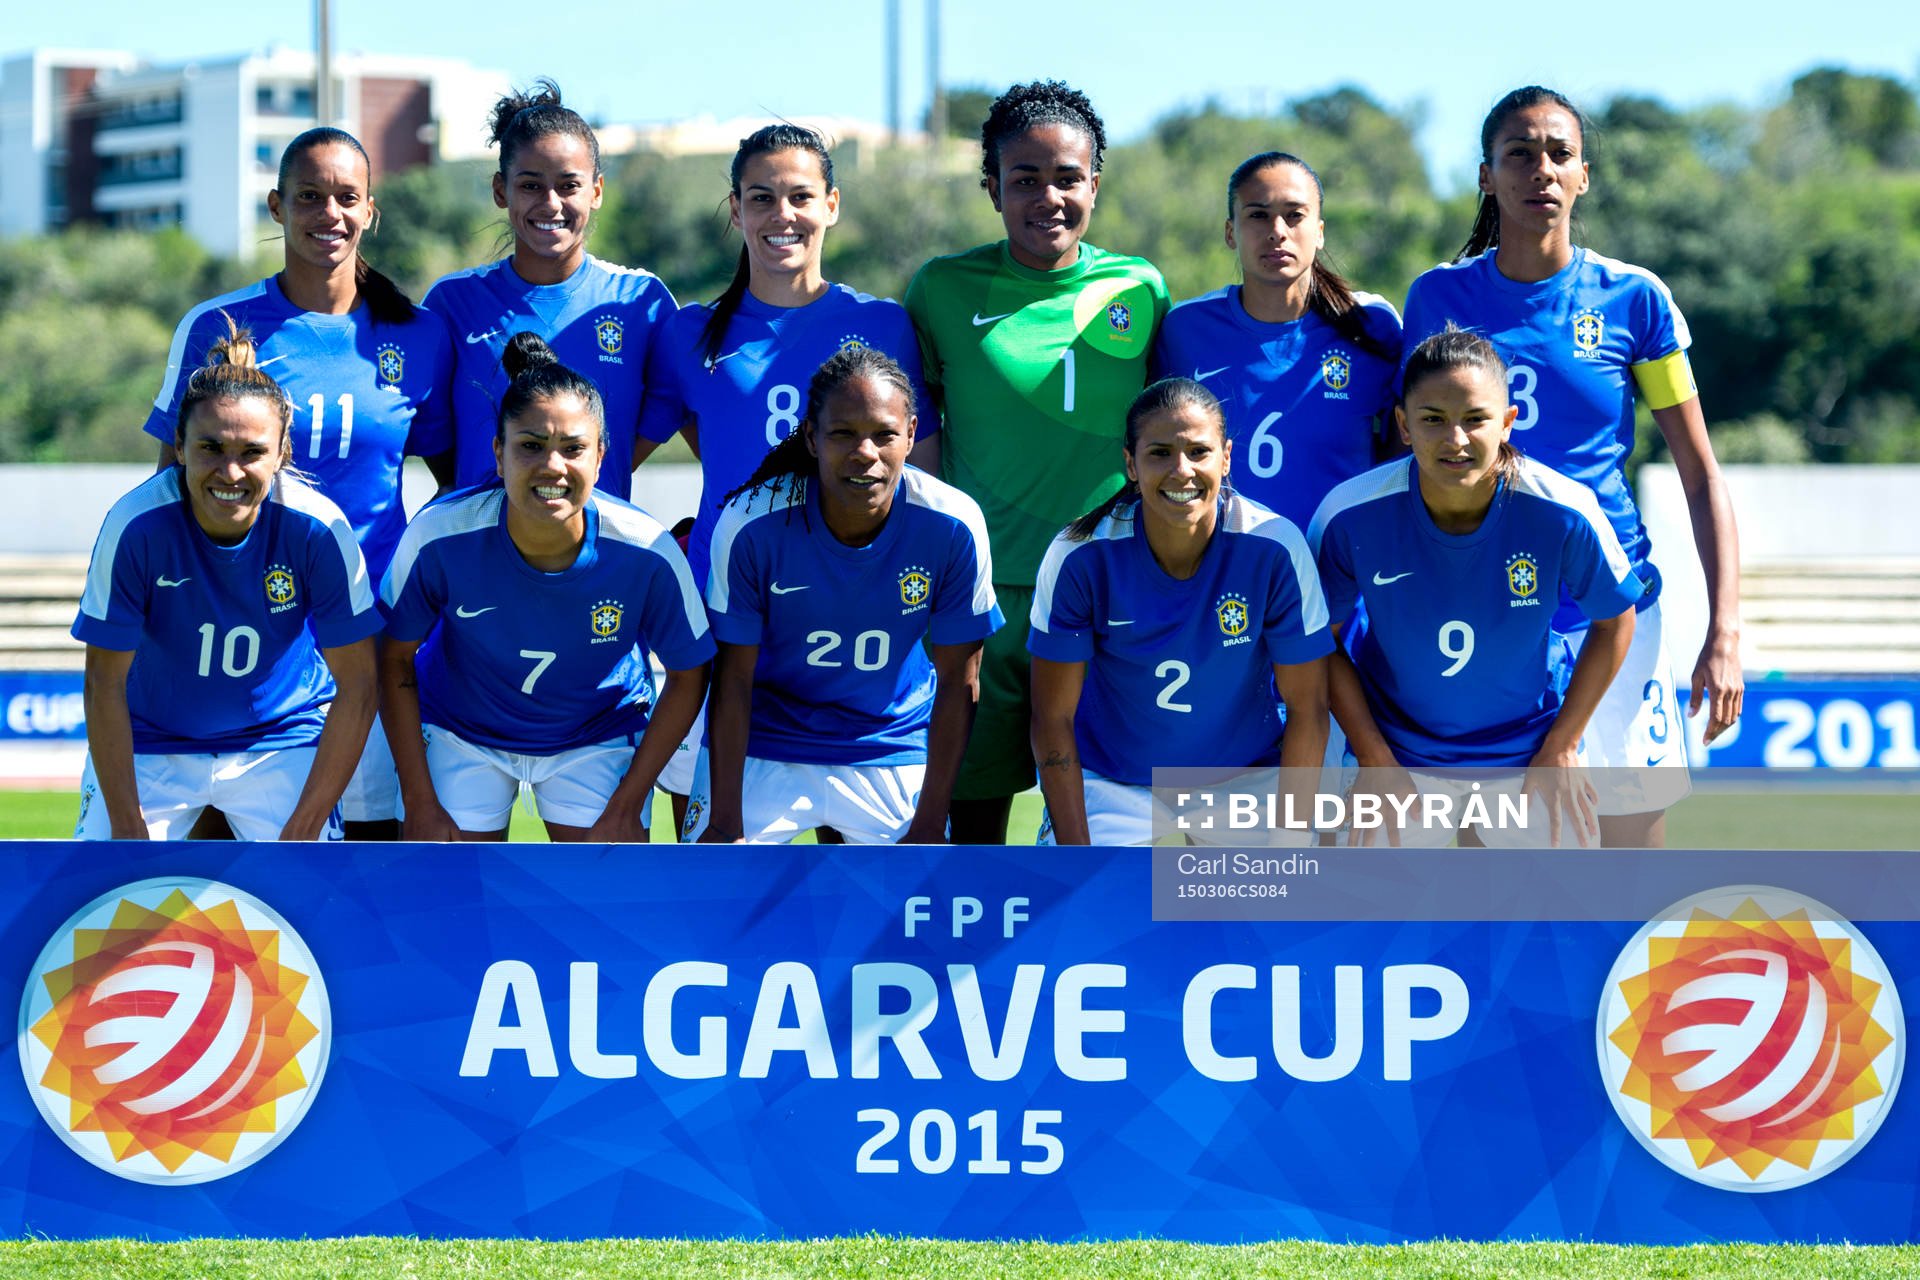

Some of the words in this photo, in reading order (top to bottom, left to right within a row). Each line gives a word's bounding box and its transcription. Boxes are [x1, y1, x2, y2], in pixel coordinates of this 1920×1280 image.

[598, 355, 624, 365] BRASIL
[1059, 349, 1076, 412] 1
[1573, 350, 1602, 360] BRASIL
[765, 384, 801, 448] 8
[1323, 391, 1349, 401] BRASIL
[1507, 365, 1539, 431] 3
[307, 393, 354, 459] 11
[1248, 412, 1283, 478] 6
[270, 602, 298, 614] BRASIL
[902, 603, 928, 616] BRASIL
[1510, 597, 1540, 608] BRASIL
[198, 623, 261, 678] 10
[591, 635, 618, 645] BRASIL
[807, 629, 890, 671] 20
[1223, 635, 1252, 648] BRASIL
[1438, 620, 1475, 678] 9
[520, 649, 557, 695] 7
[1155, 660, 1192, 713] 2
[1645, 679, 1669, 745] 3
[458, 959, 1127, 1082] ALGARVE
[1183, 963, 1470, 1083] CUP
[856, 1108, 1064, 1175] 2015
